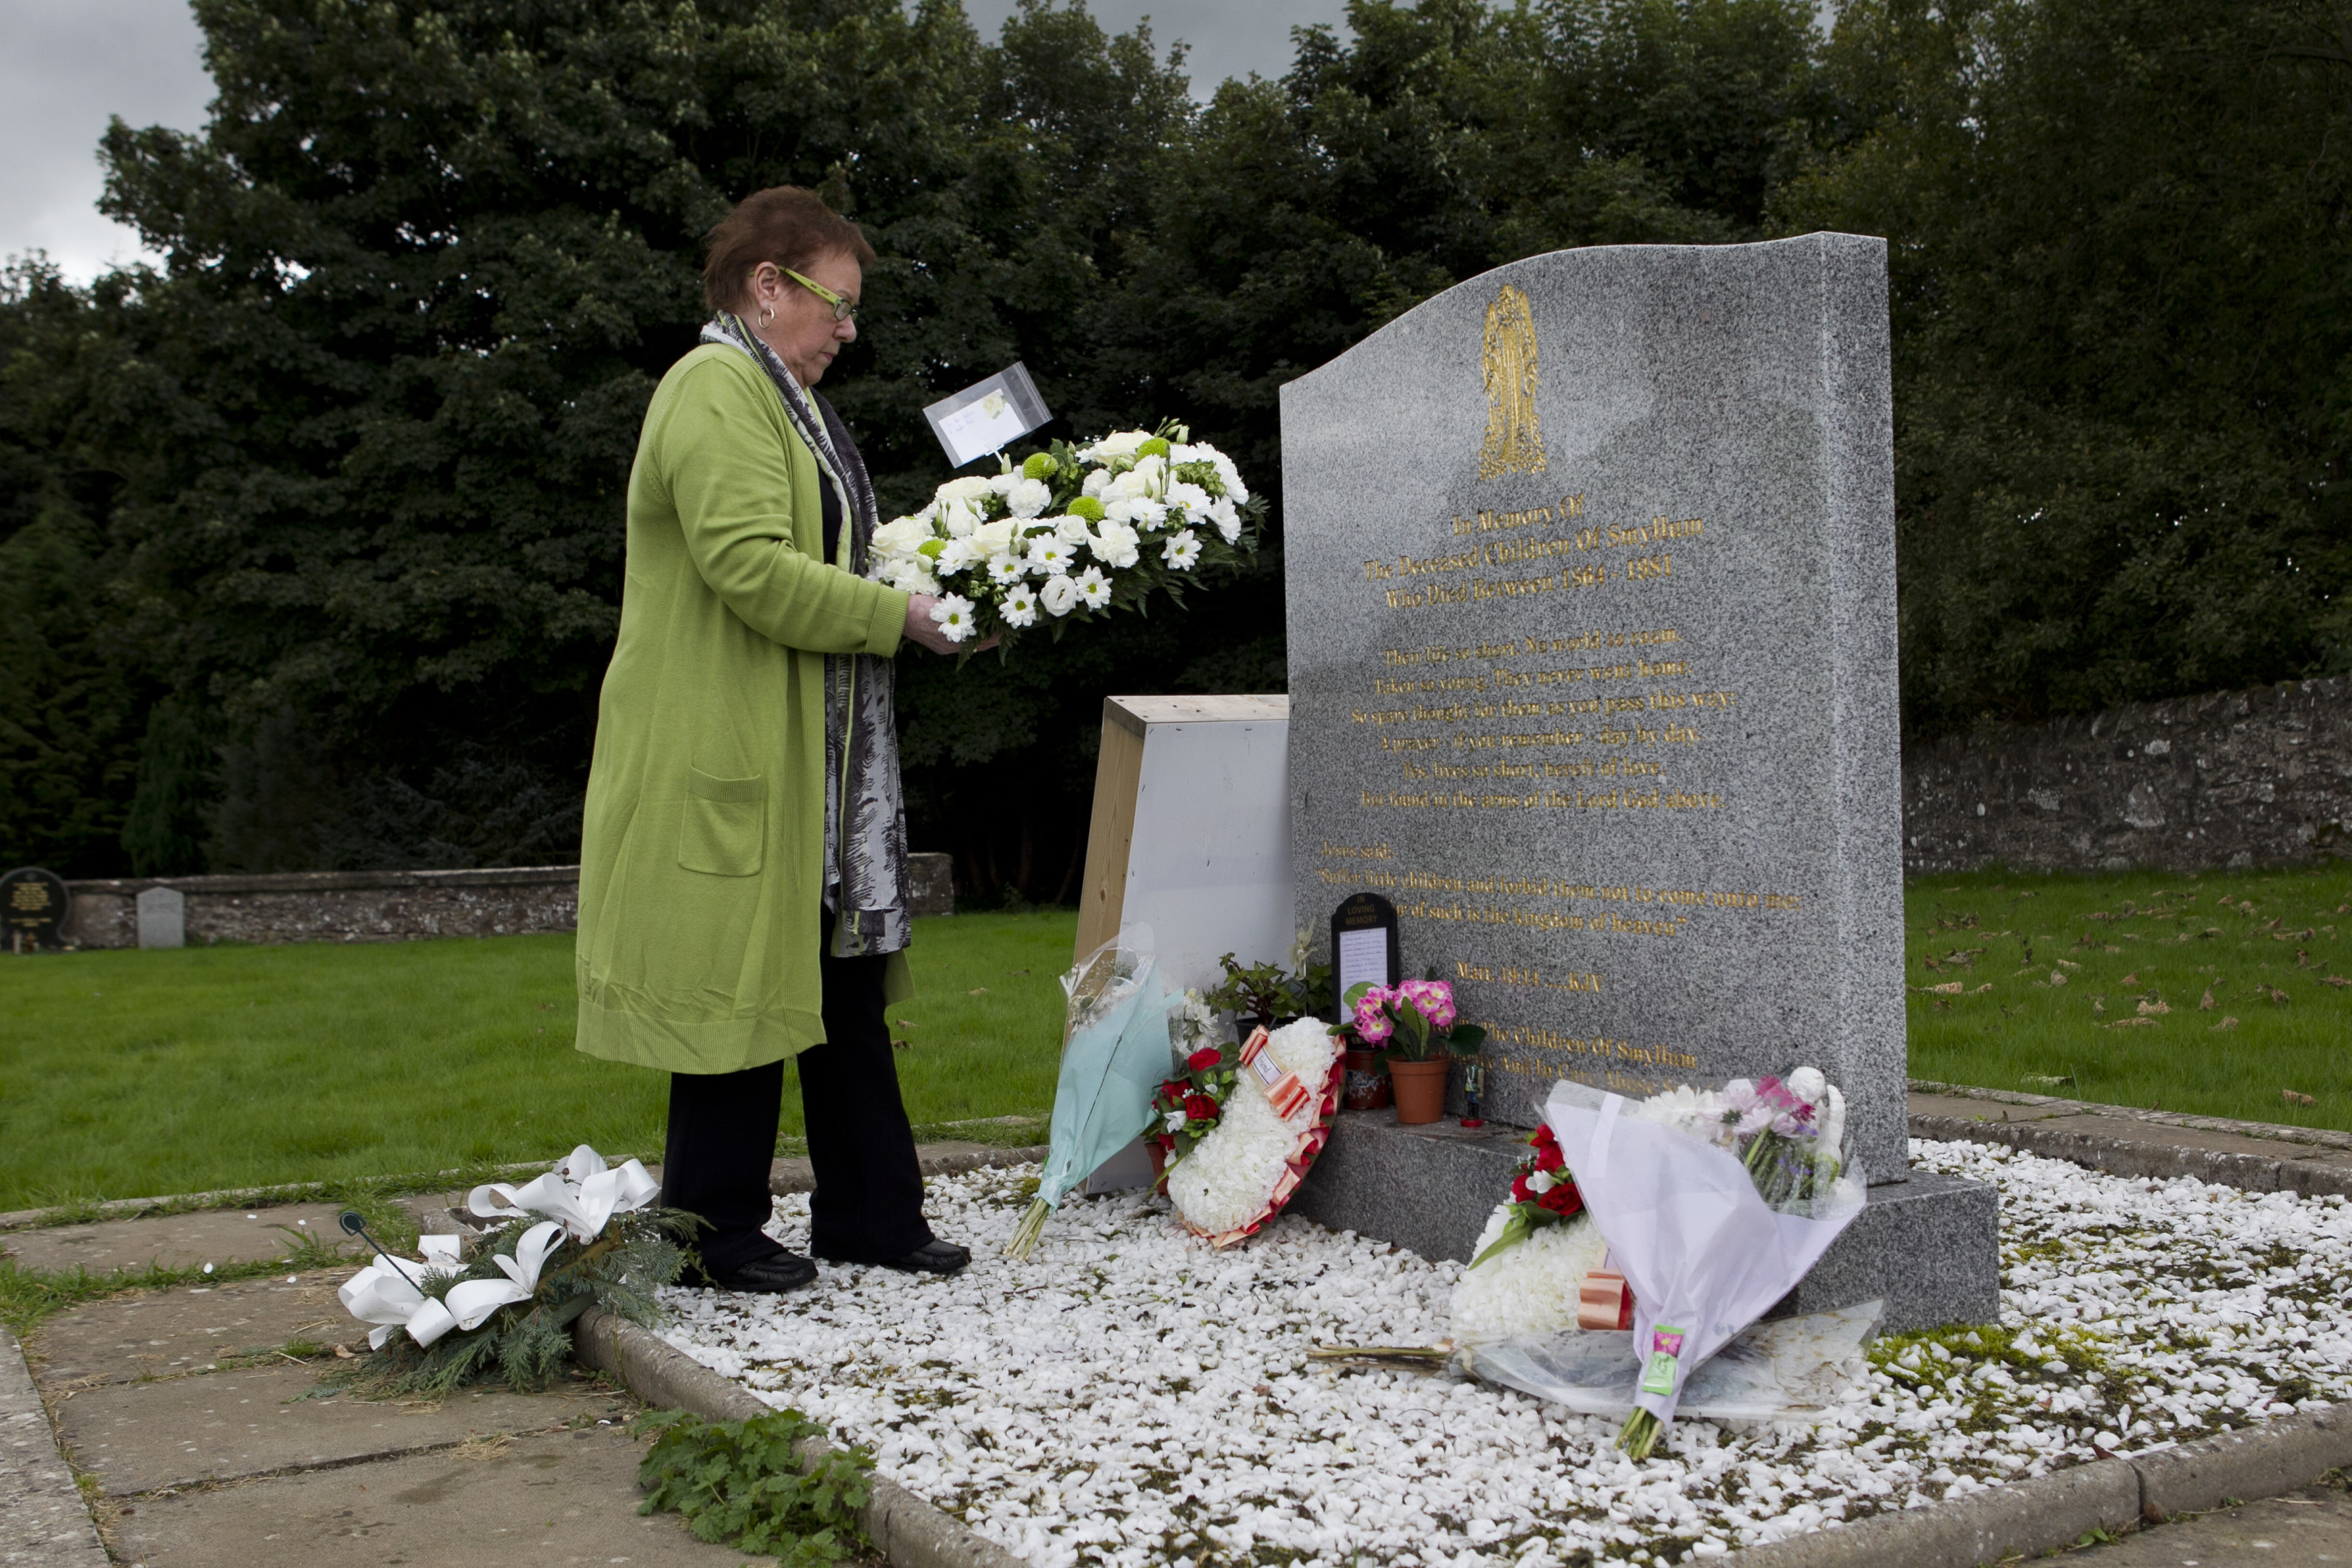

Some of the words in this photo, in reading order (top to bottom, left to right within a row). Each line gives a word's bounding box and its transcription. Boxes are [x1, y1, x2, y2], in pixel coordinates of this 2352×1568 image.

[1453, 515, 1472, 536] In
[1478, 507, 1553, 533] Memory
[1561, 492, 1584, 519] Of
[1364, 559, 1393, 581] The
[1399, 544, 1479, 576] Deceased
[1485, 536, 1569, 565] Children
[1577, 526, 1601, 552] Of
[1608, 515, 1703, 549] Smyllum
[1387, 587, 1421, 609] Who
[1427, 580, 1467, 605] Died
[1474, 575, 1553, 600] Between
[1562, 563, 1605, 589] 1864
[1628, 554, 1672, 581] 1981
[1384, 648, 1422, 666] Their
[1426, 645, 1450, 662] life
[1455, 647, 1471, 661] so
[1526, 635, 1547, 653] No
[1552, 629, 1601, 651] world
[1606, 632, 1625, 648] to
[1631, 628, 1682, 646] roam.
[1374, 677, 1416, 695] Taken
[1420, 679, 1435, 692] so
[1494, 668, 1532, 690] They
[1538, 669, 1584, 685] never
[1590, 663, 1632, 680] went
[1638, 658, 1693, 678] home.
[1351, 707, 1367, 724] So
[1371, 708, 1408, 727] spare
[1413, 703, 1470, 723] thought
[1474, 701, 1496, 718] for
[1501, 698, 1540, 717] them
[1546, 701, 1564, 715] as
[1569, 699, 1598, 719] you
[1606, 697, 1644, 716] pass
[1649, 689, 1686, 710] this
[1380, 735, 1389, 751] A
[1392, 737, 1439, 755] prayer
[1454, 731, 1465, 748] if
[1469, 735, 1496, 753] you
[1501, 727, 1583, 748] remember
[1599, 724, 1631, 748] day
[1636, 723, 1658, 748] by
[1665, 722, 1702, 746] day.
[1434, 761, 1469, 778] lives
[1473, 766, 1489, 778] so
[1493, 759, 1540, 779] short,
[1544, 757, 1594, 777] bereft
[1601, 756, 1618, 777] of
[1623, 756, 1666, 777] love.
[1361, 790, 1384, 807] But
[1389, 790, 1429, 807] found
[1434, 791, 1448, 807] in
[1453, 789, 1477, 807] the
[1482, 794, 1519, 807] arms
[1524, 789, 1540, 808] of
[1545, 788, 1571, 808] the
[1577, 788, 1617, 809] Lord
[1623, 788, 1659, 809] God
[1665, 788, 1726, 809] above.
[1320, 841, 1357, 857] Jesus
[1357, 894, 1365, 904] IN
[1365, 869, 1398, 887] little
[1402, 871, 1462, 891] children
[1467, 875, 1495, 894] and
[1499, 875, 1548, 897] forbid
[1553, 878, 1595, 899] them
[1601, 883, 1629, 902] not
[1636, 883, 1653, 902] to
[1659, 889, 1707, 905] come
[1713, 888, 1759, 908] unto
[1345, 915, 1377, 926] MEMORY
[1347, 905, 1375, 915] LOVING
[1411, 900, 1426, 918] of
[1429, 902, 1462, 921] such
[1467, 904, 1480, 922] is
[1485, 905, 1509, 924] the
[1514, 907, 1583, 931] kingdom
[1590, 911, 1606, 931] of
[1457, 960, 1495, 981] Matt.
[1502, 965, 1538, 987] 19:14
[1514, 1026, 1585, 1053] Children
[1592, 1036, 1612, 1057] Of
[1617, 1040, 1696, 1069] Smyllum
[1257, 1055, 1273, 1074] Friend
[1500, 1054, 1530, 1074] And
[1536, 1058, 1553, 1079] In
